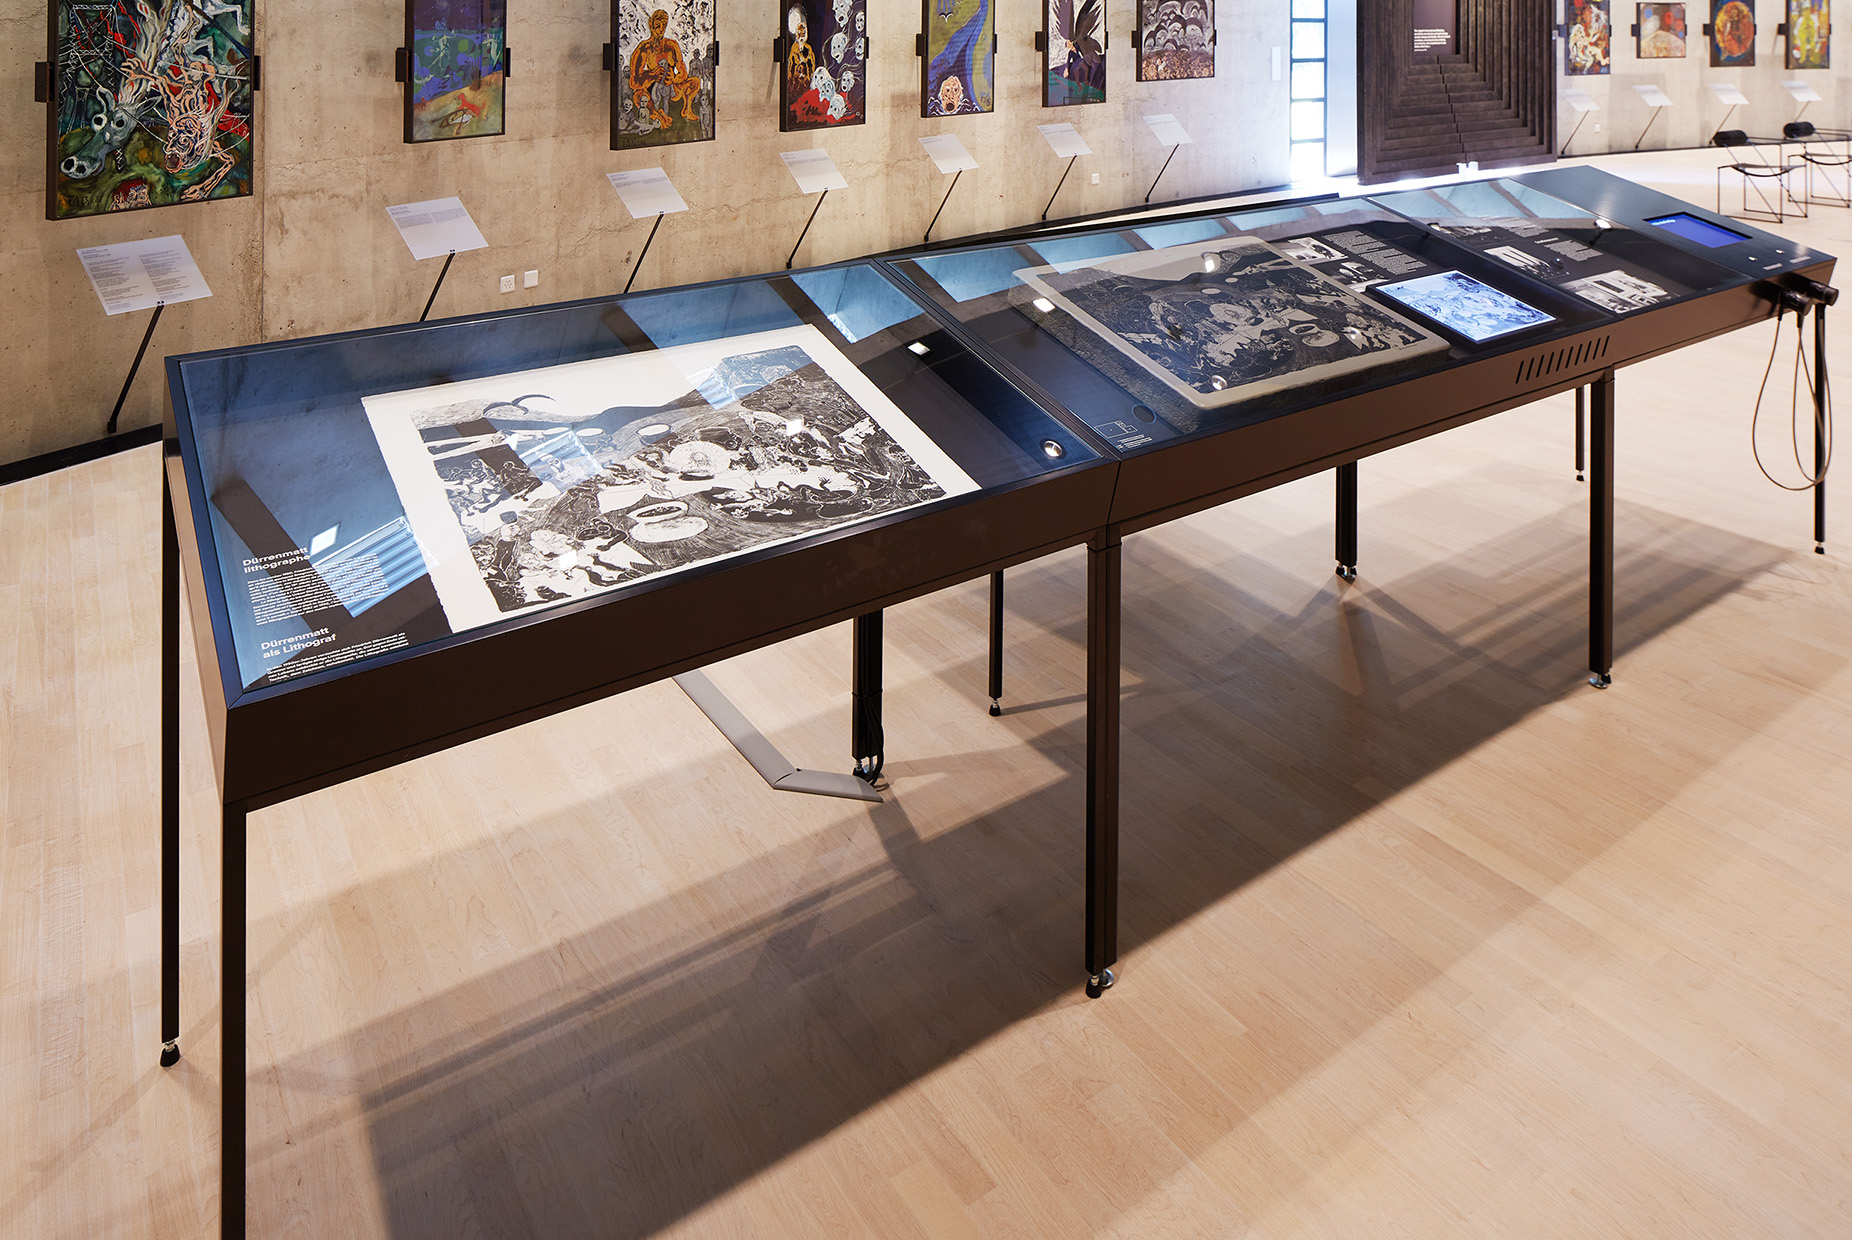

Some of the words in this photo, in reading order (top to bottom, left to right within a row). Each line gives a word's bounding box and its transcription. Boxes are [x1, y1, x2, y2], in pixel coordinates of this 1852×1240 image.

[242, 547, 308, 566] Dürrenmatt
[244, 555, 311, 574] lithographe
[261, 627, 329, 650] Dürrenmatt
[263, 649, 281, 659] als
[283, 633, 336, 653] Lithograf
